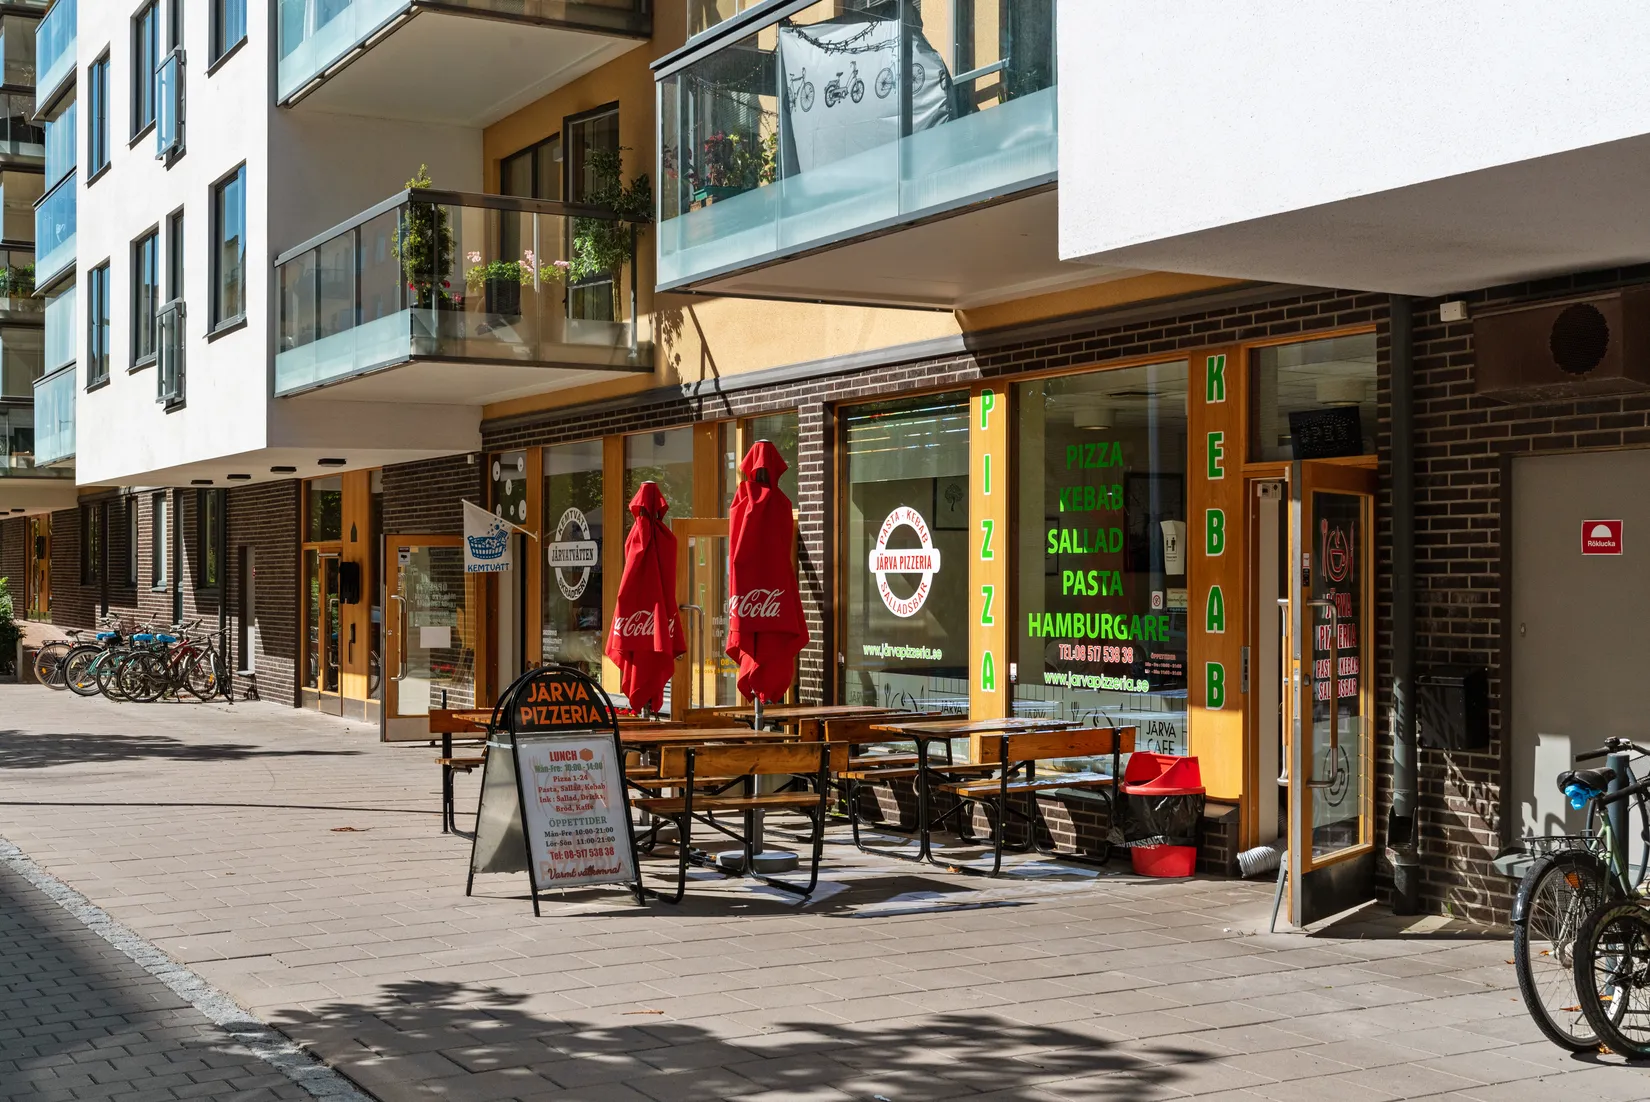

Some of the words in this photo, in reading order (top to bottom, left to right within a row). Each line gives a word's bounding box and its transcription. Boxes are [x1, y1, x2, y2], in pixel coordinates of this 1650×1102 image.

[1066, 441, 1123, 470] PIZZA
[1060, 484, 1124, 512] KEBAB
[880, 511, 900, 545] PASTA
[906, 509, 929, 543] KEBAB
[1206, 354, 1227, 710] KEBAB
[981, 389, 995, 692] PIZZA
[1047, 527, 1124, 554] SALLAD
[876, 553, 898, 570] JÄRVA
[899, 554, 932, 570] PIZZERIA
[1062, 570, 1124, 596] PASTA
[881, 582, 927, 615] SALLADSBAR
[1028, 612, 1170, 641] HAMBURGARE
[1087, 645, 1101, 662] 517
[1103, 645, 1120, 663] 538
[1122, 646, 1133, 664] 38
[527, 682, 589, 703] JÄRVA
[1319, 678, 1357, 701] SALDSBAR
[520, 705, 602, 726] PIZZERIA
[1146, 720, 1176, 738] JÄRVA
[549, 750, 578, 762] LUNCH
[585, 782, 606, 790] Kebab
[544, 830, 572, 838] Mån-Fre
[575, 827, 614, 836] 10:00-21:00
[549, 816, 607, 828] ÖPPETTIDER
[576, 836, 616, 846] 11:00-21:00
[550, 851, 564, 861] Tel:
[564, 848, 588, 860] 08-517
[589, 847, 604, 858] 538
[604, 846, 615, 857] 38
[547, 868, 577, 880] Varmt
